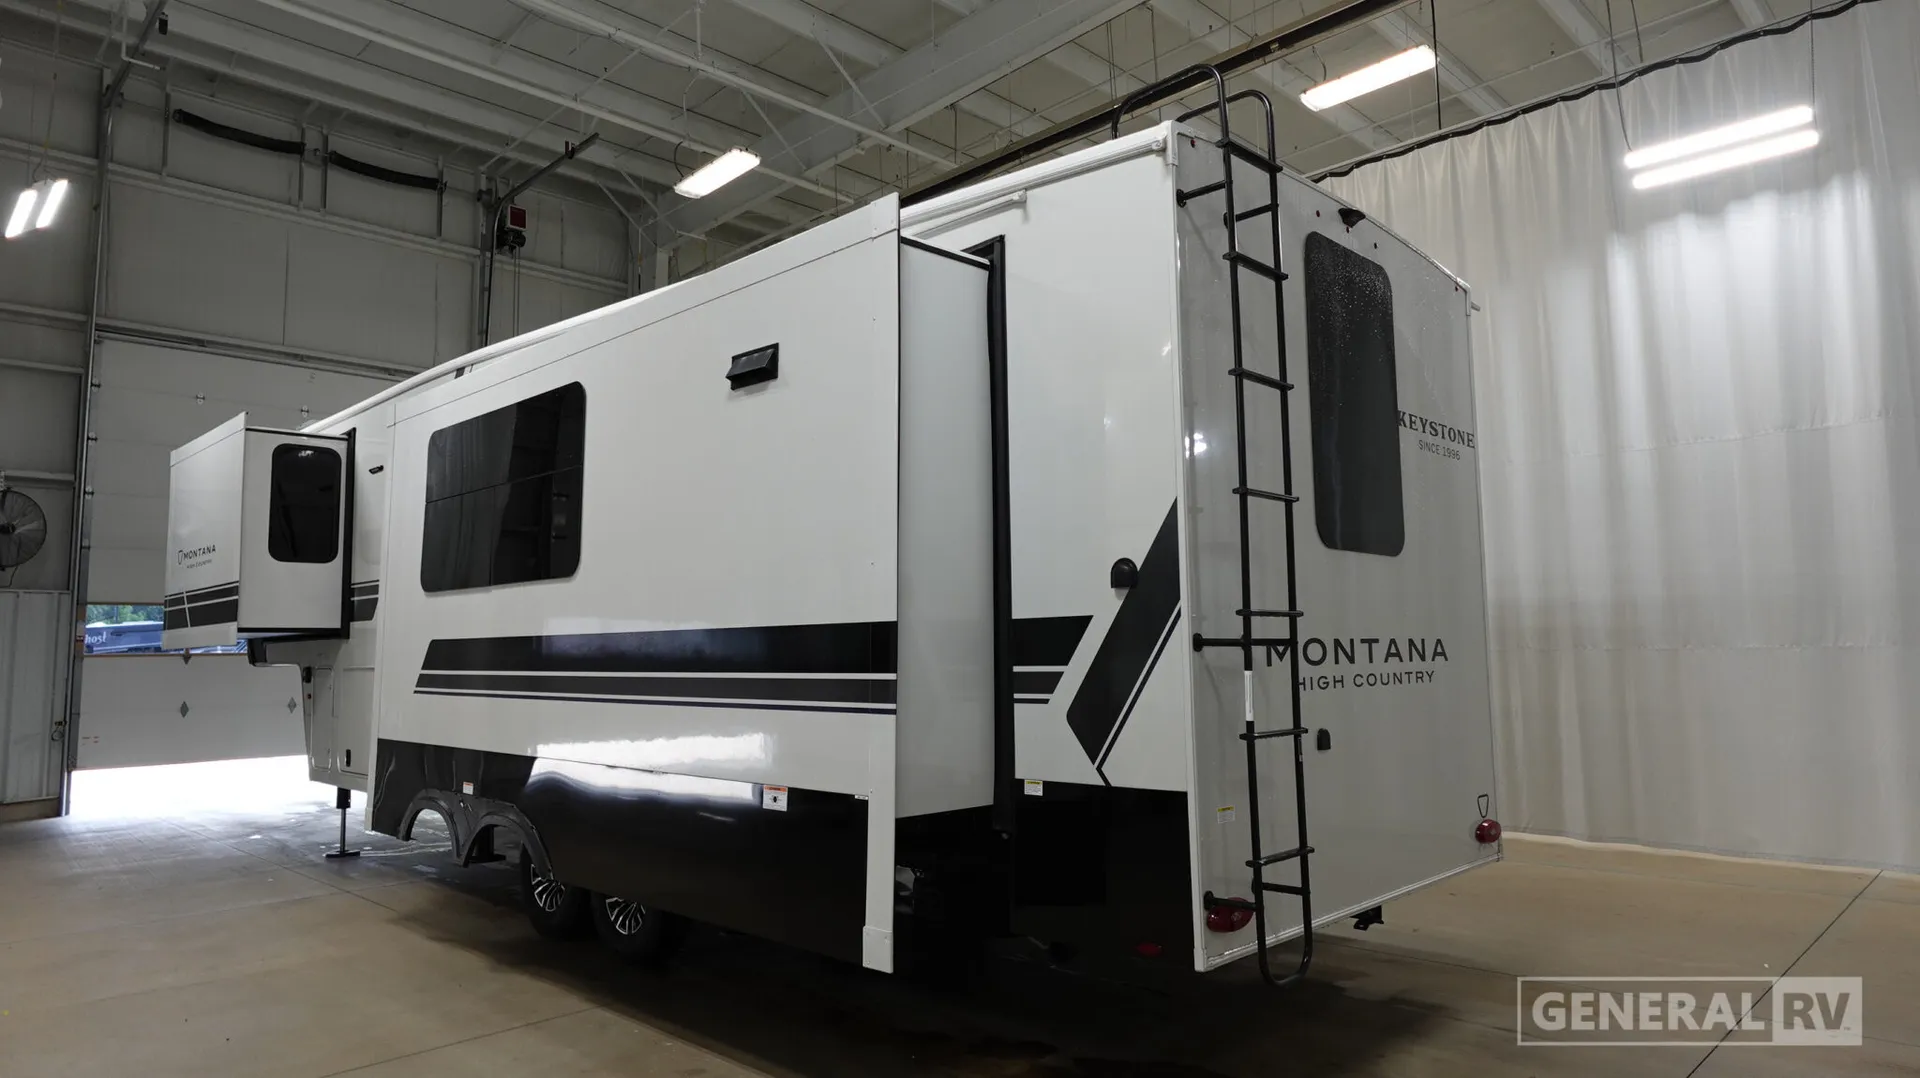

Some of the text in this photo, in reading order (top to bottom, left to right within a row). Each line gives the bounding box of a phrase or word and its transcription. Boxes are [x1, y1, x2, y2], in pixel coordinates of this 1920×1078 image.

[1396, 409, 1475, 449] KEYSTONE
[1418, 439, 1461, 461] SINCE 1996
[183, 544, 216, 561] MONTANA
[1265, 637, 1449, 667] MONTANA
[1352, 670, 1435, 688] COUNTRY
